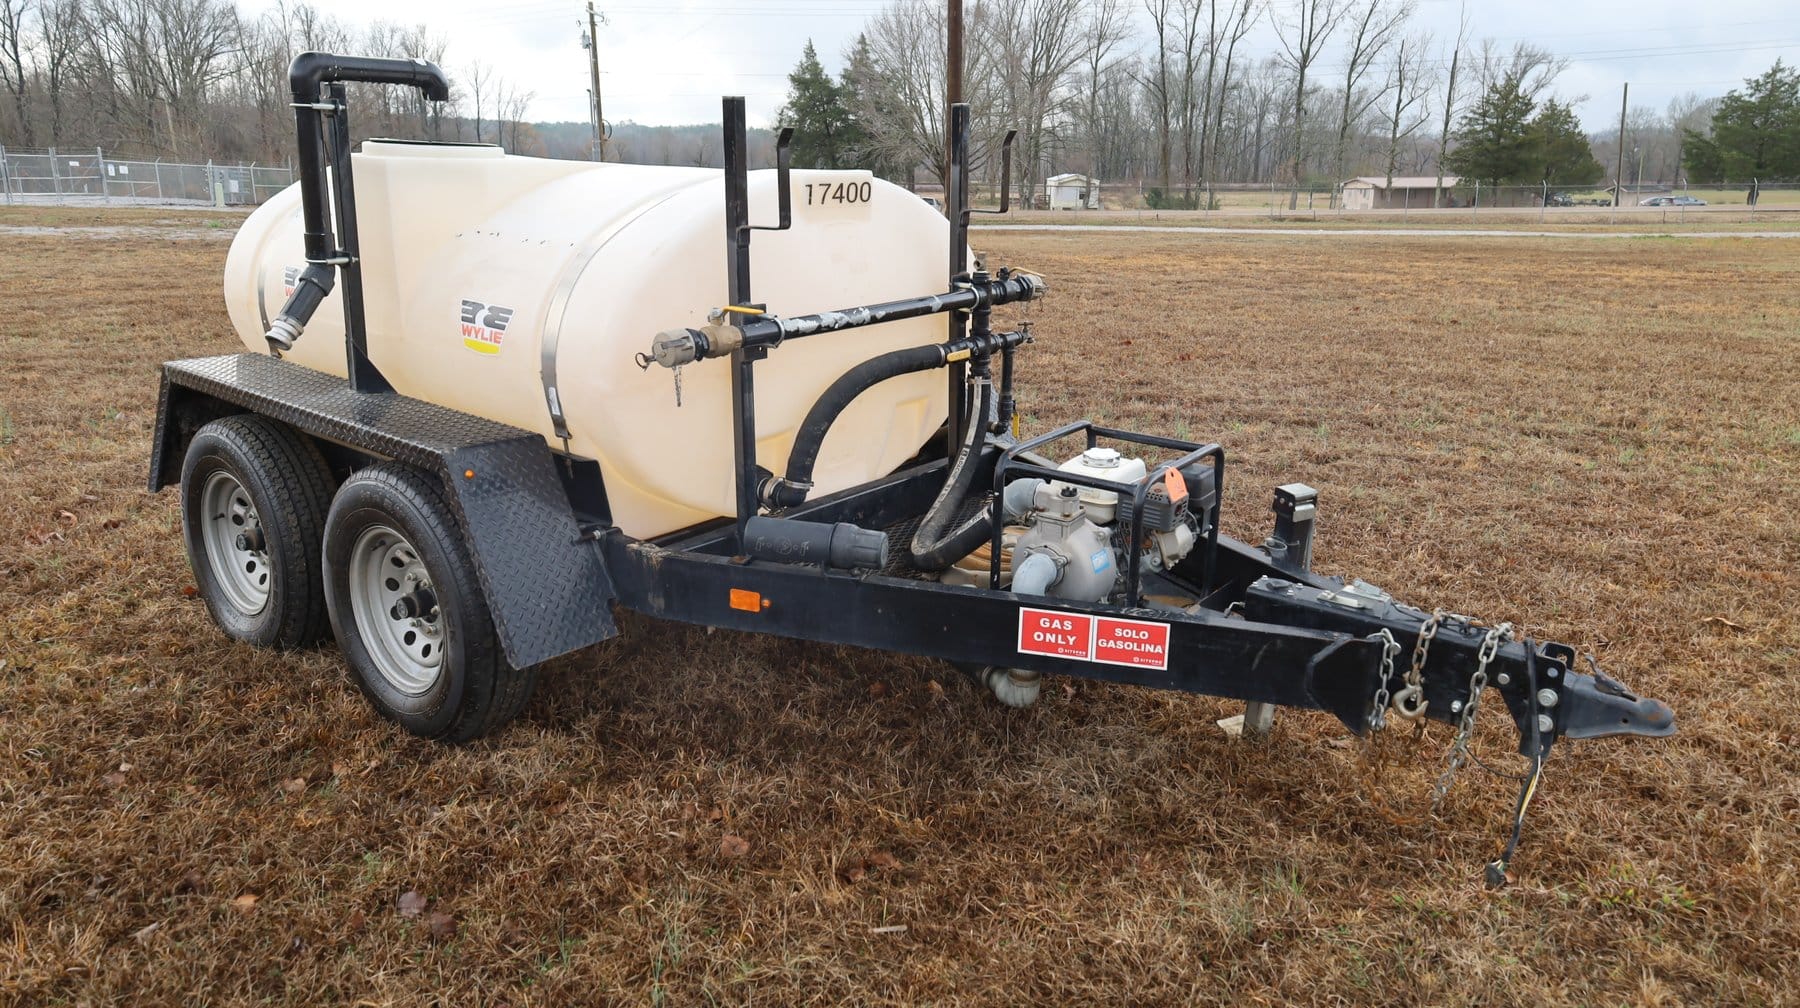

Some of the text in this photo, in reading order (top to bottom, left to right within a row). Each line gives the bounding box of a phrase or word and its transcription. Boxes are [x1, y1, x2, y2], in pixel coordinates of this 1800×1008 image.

[805, 181, 872, 205] 17400
[461, 323, 504, 345] WYLIE
[1039, 617, 1073, 631] GAS
[1033, 631, 1077, 646] ONLY
[1114, 627, 1149, 640] SOLO
[1098, 638, 1163, 654] GASOLINA
